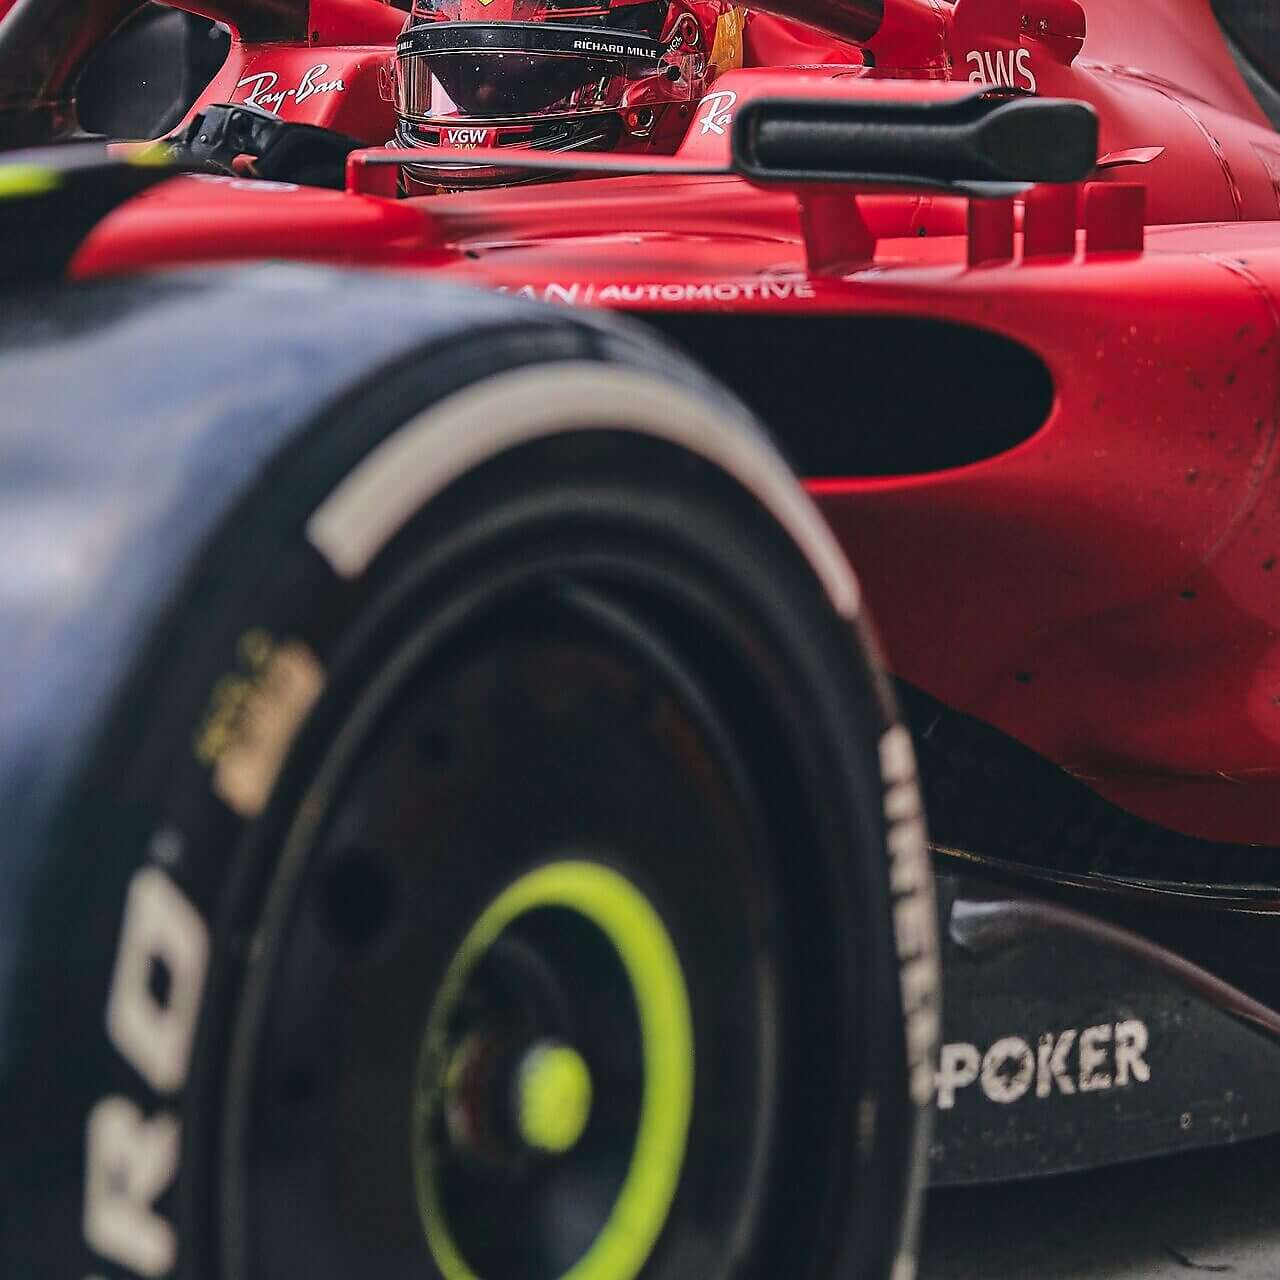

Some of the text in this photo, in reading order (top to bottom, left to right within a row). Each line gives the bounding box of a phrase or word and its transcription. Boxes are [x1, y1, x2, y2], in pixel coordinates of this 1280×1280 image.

[573, 39, 657, 59] RICHARD MILLE
[966, 48, 1037, 96] aws
[447, 129, 488, 144] VGW
[598, 280, 817, 302] AUTOMOTIVE
[934, 1019, 1151, 1110] POKER
